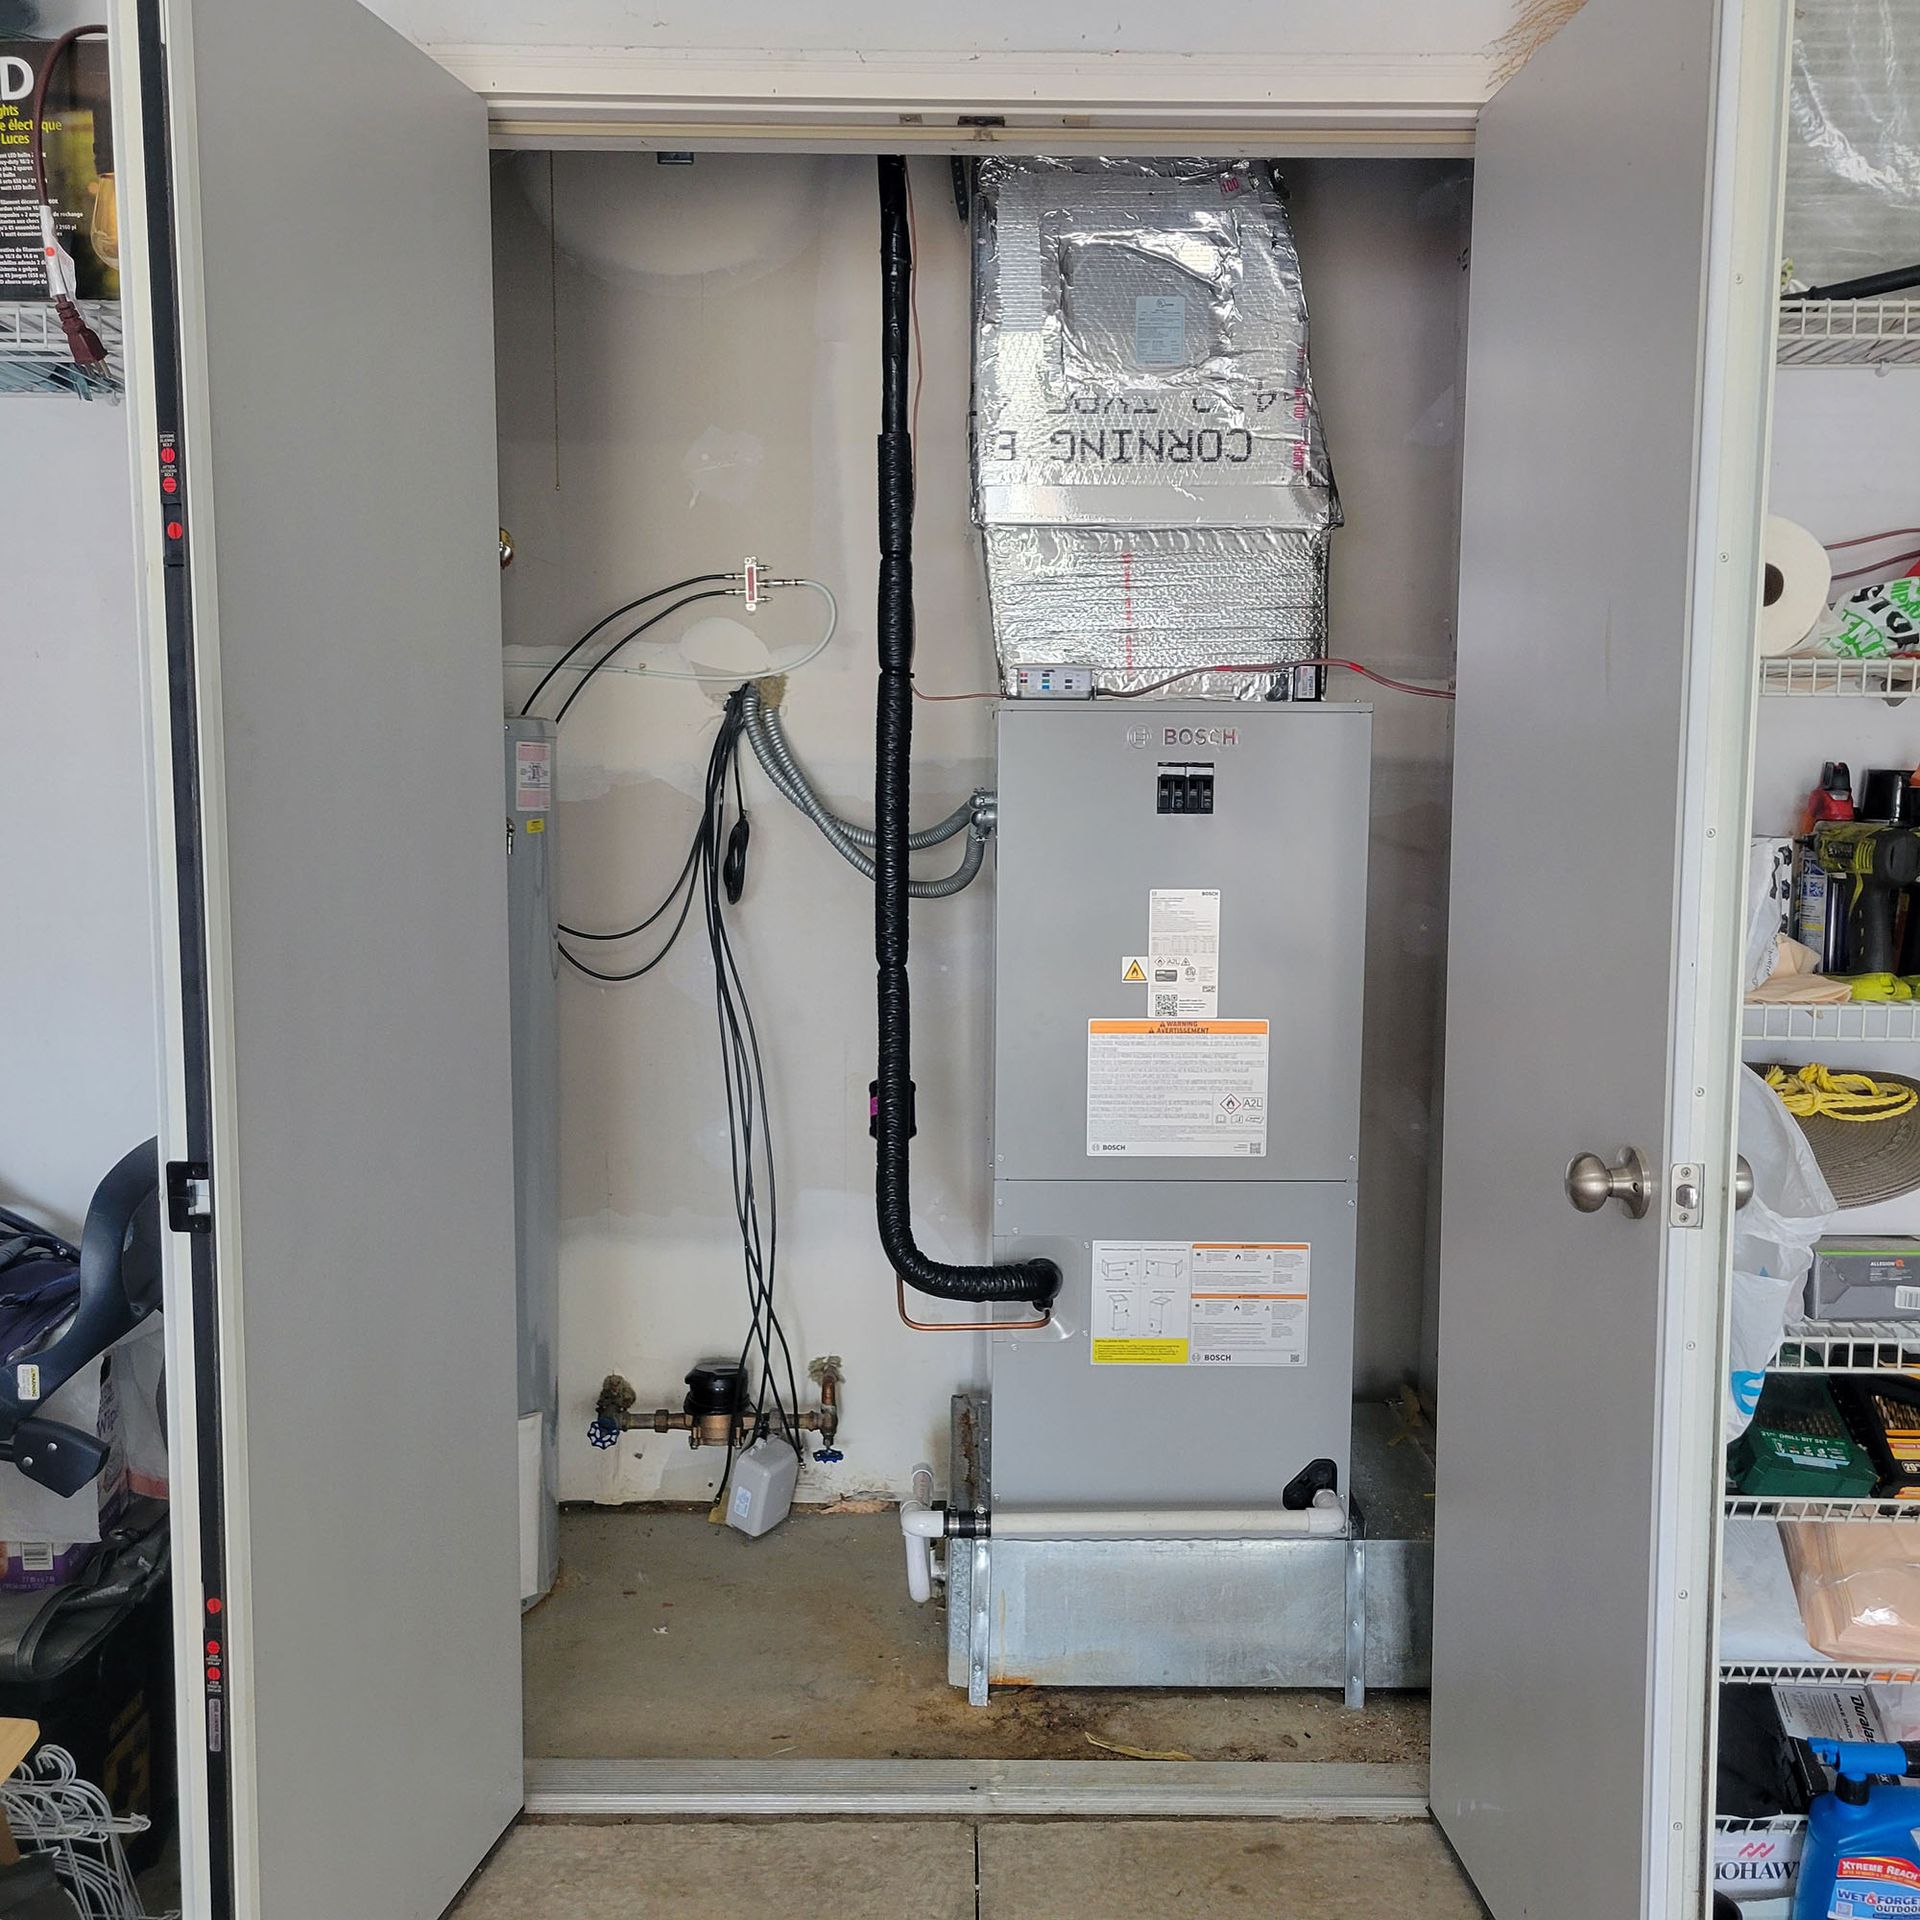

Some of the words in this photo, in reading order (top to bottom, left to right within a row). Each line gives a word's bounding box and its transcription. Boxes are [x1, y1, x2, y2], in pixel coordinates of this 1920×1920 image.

[8, 118, 63, 133] électque
[1, 133, 30, 144] Luces
[1049, 429, 1252, 462] CORNING
[1162, 727, 1239, 746] BOSCH
[1244, 1097, 1263, 1109] A2L
[1204, 1354, 1231, 1362] BOSCH
[1778, 1433, 1800, 1442] DRILL
[1800, 1436, 1813, 1444] BIT
[1849, 1693, 1876, 1743] Duralas
[1842, 1717, 1854, 1739] PADS
[1715, 1860, 1800, 1881] OHAW
[1841, 1861, 1884, 1873] XTREME
[1886, 1865, 1919, 1881] REACH
